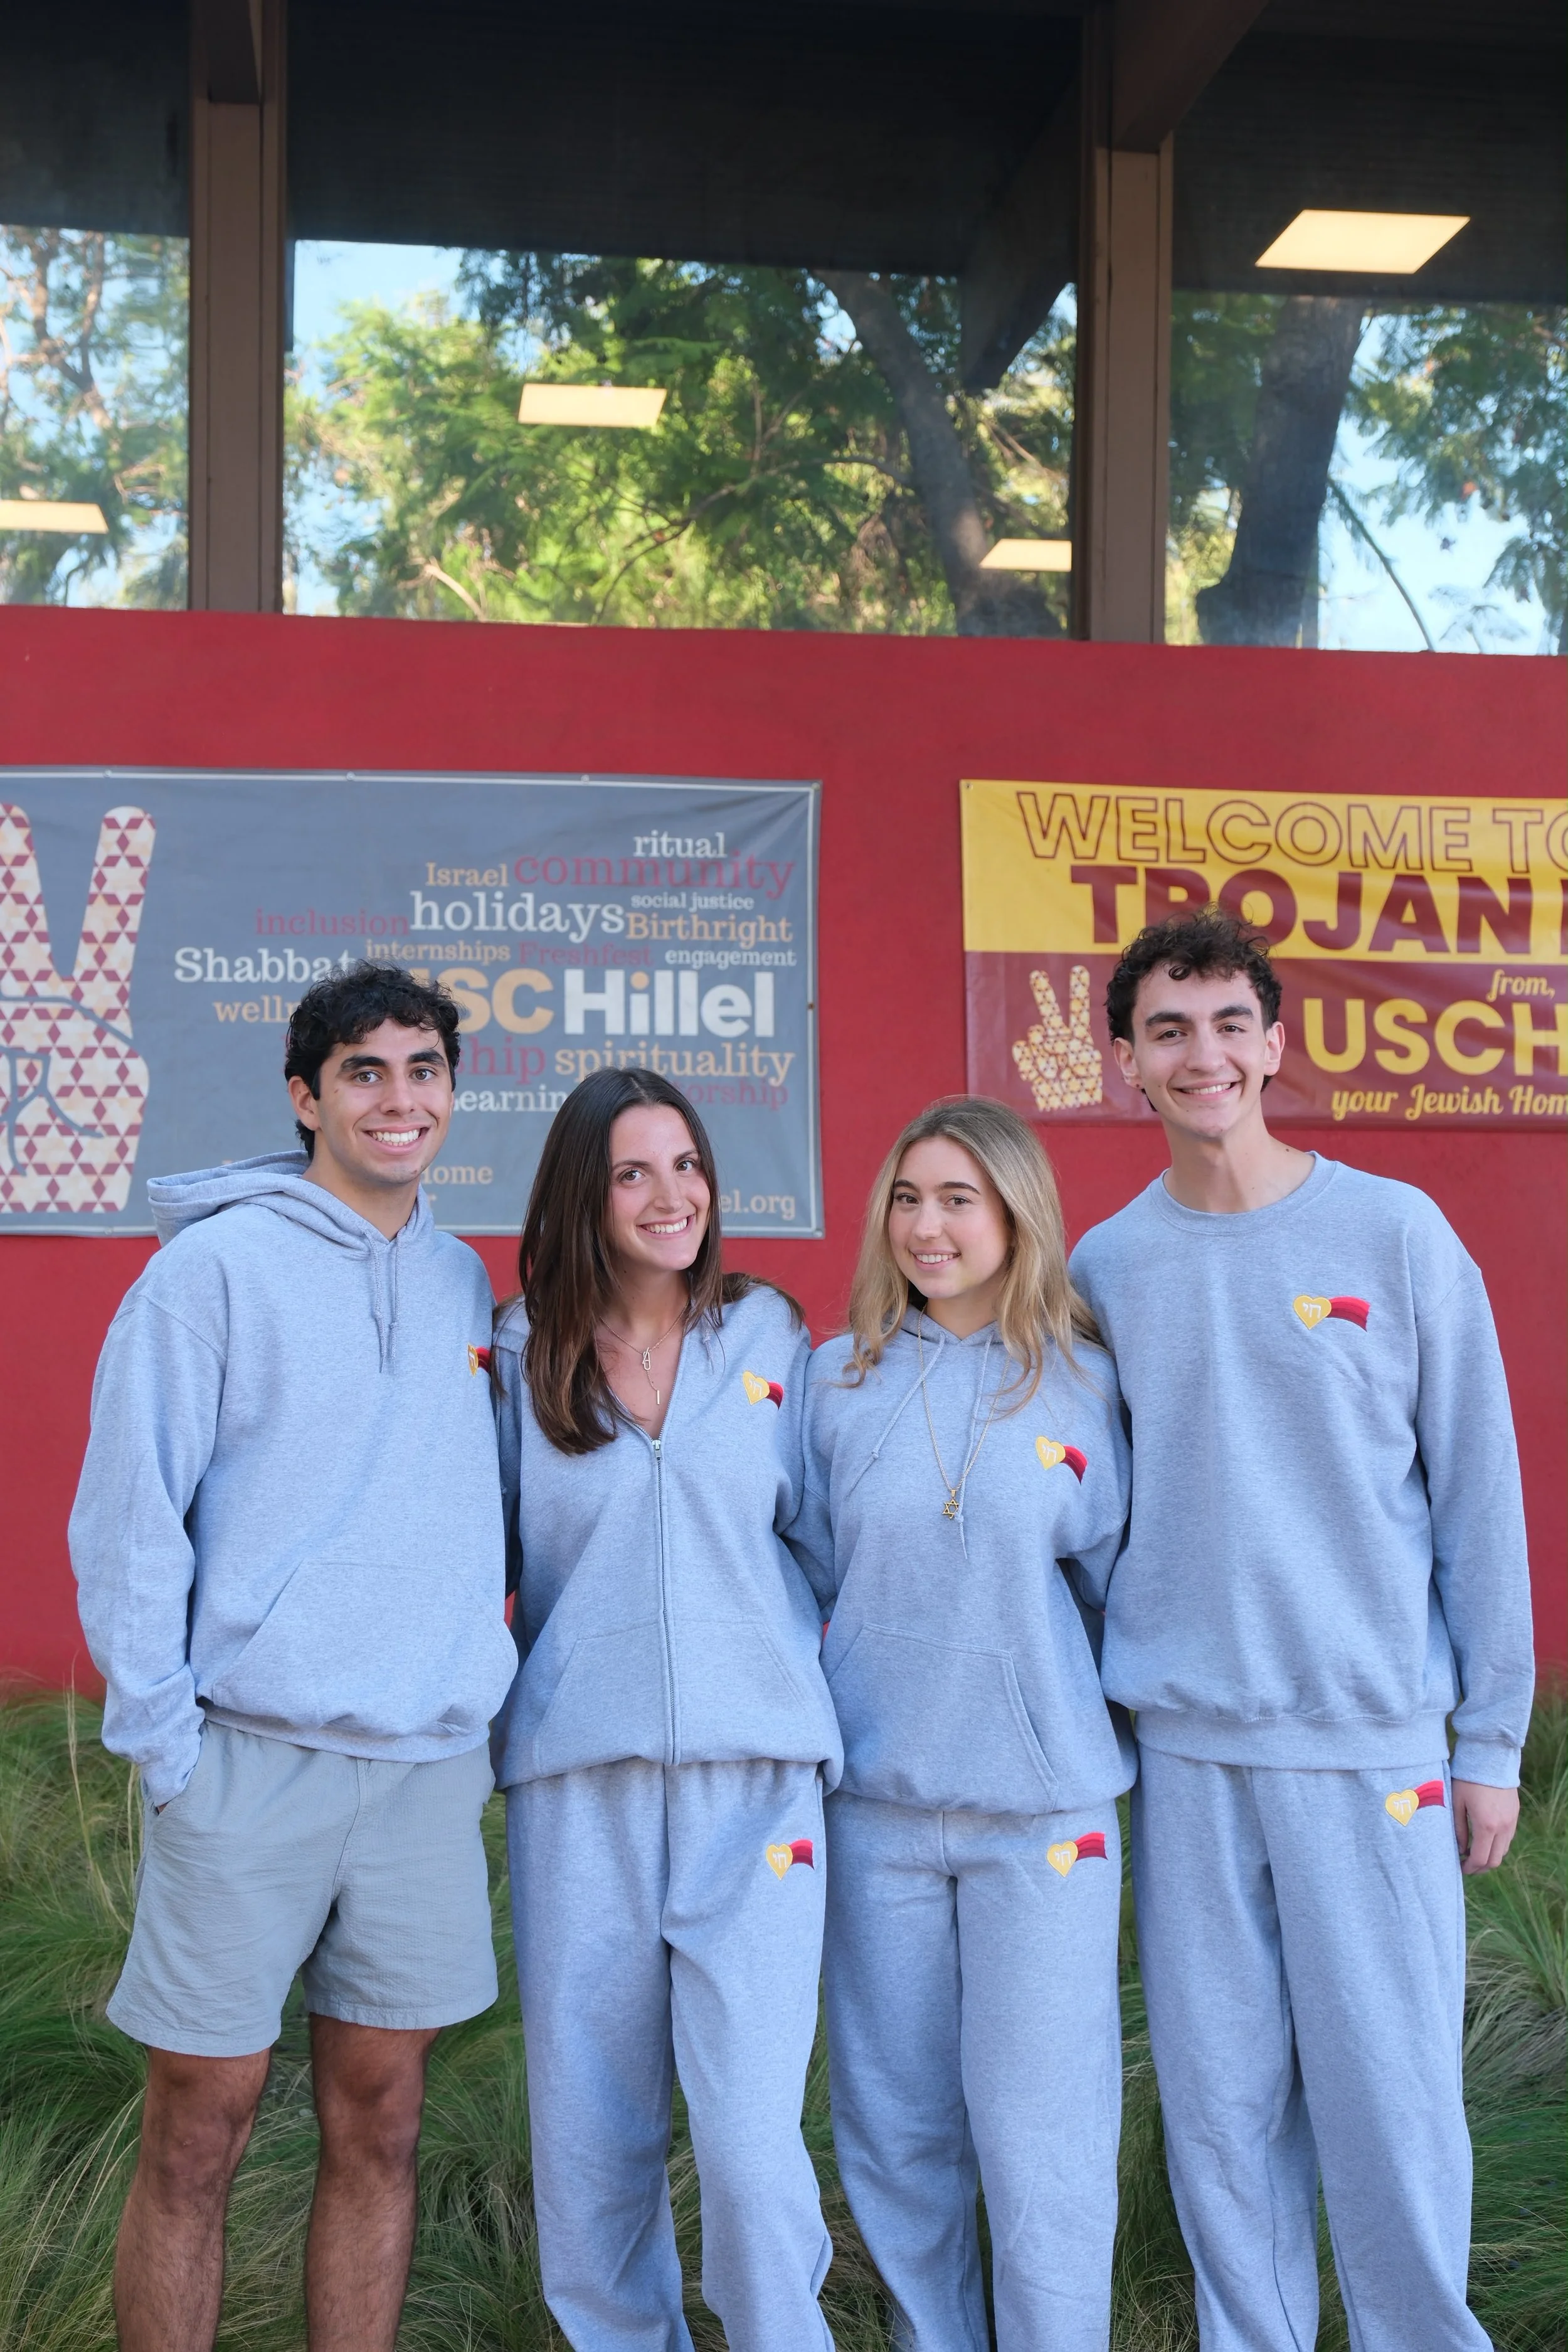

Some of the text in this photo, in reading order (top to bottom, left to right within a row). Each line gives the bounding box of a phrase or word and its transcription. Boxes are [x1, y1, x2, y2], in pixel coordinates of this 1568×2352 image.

[633, 829, 727, 858] ritual
[1016, 791, 1474, 873] WELCOME
[425, 862, 509, 886] Israel
[514, 851, 797, 900] community
[410, 890, 625, 943] holidays
[631, 892, 755, 912] social justice
[255, 908, 410, 935] inclusion
[625, 912, 793, 950] Birthright
[365, 939, 511, 966] internships
[518, 942, 654, 967] Freshfest
[665, 949, 797, 970] engagement
[1486, 969, 1555, 1003] from,
[554, 1039, 796, 1087] spirituality
[1332, 1087, 1398, 1121] your
[1404, 1083, 1503, 1121] Jewish
